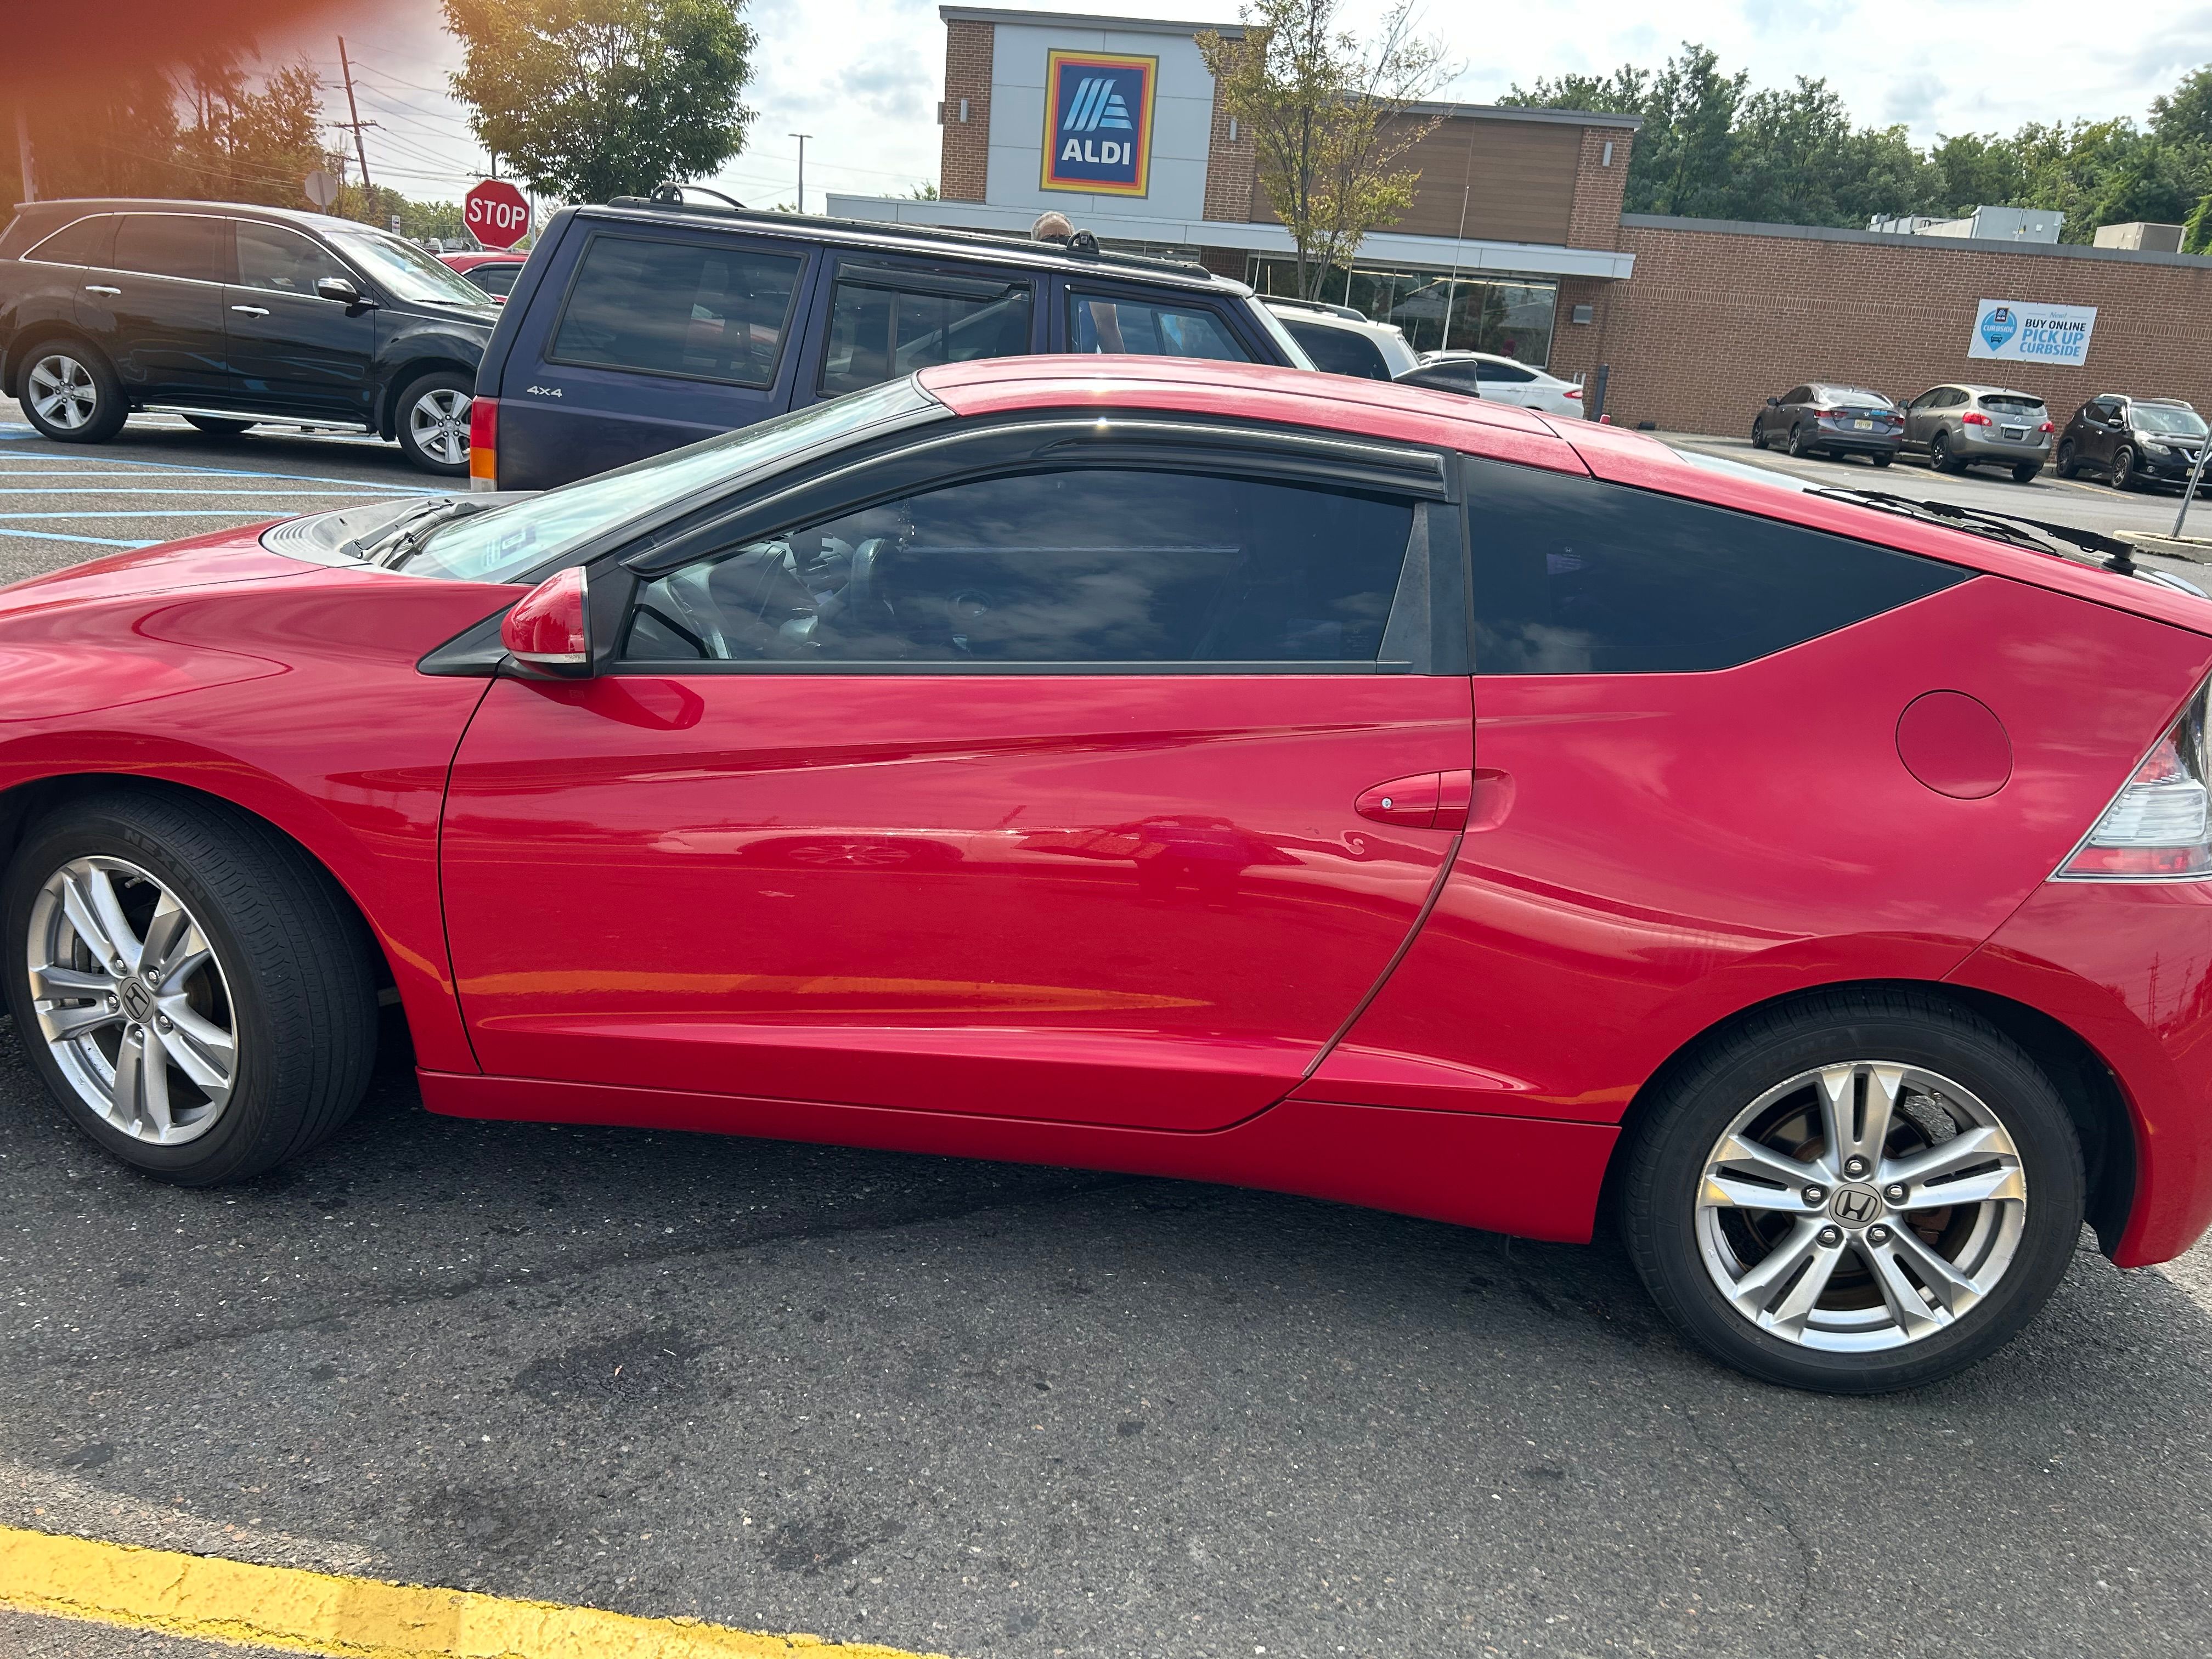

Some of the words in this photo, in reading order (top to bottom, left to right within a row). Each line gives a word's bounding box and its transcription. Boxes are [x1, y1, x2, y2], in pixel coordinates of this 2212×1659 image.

[1061, 138, 1131, 165] ALDI
[469, 198, 526, 230] STOP
[2025, 318, 2047, 329] BUY
[2049, 320, 2086, 331] ONLINE
[2022, 328, 2059, 343] PICK
[2062, 331, 2084, 345] UP
[2019, 342, 2081, 357] CURBSIDE
[125, 829, 206, 901] NEXEN
